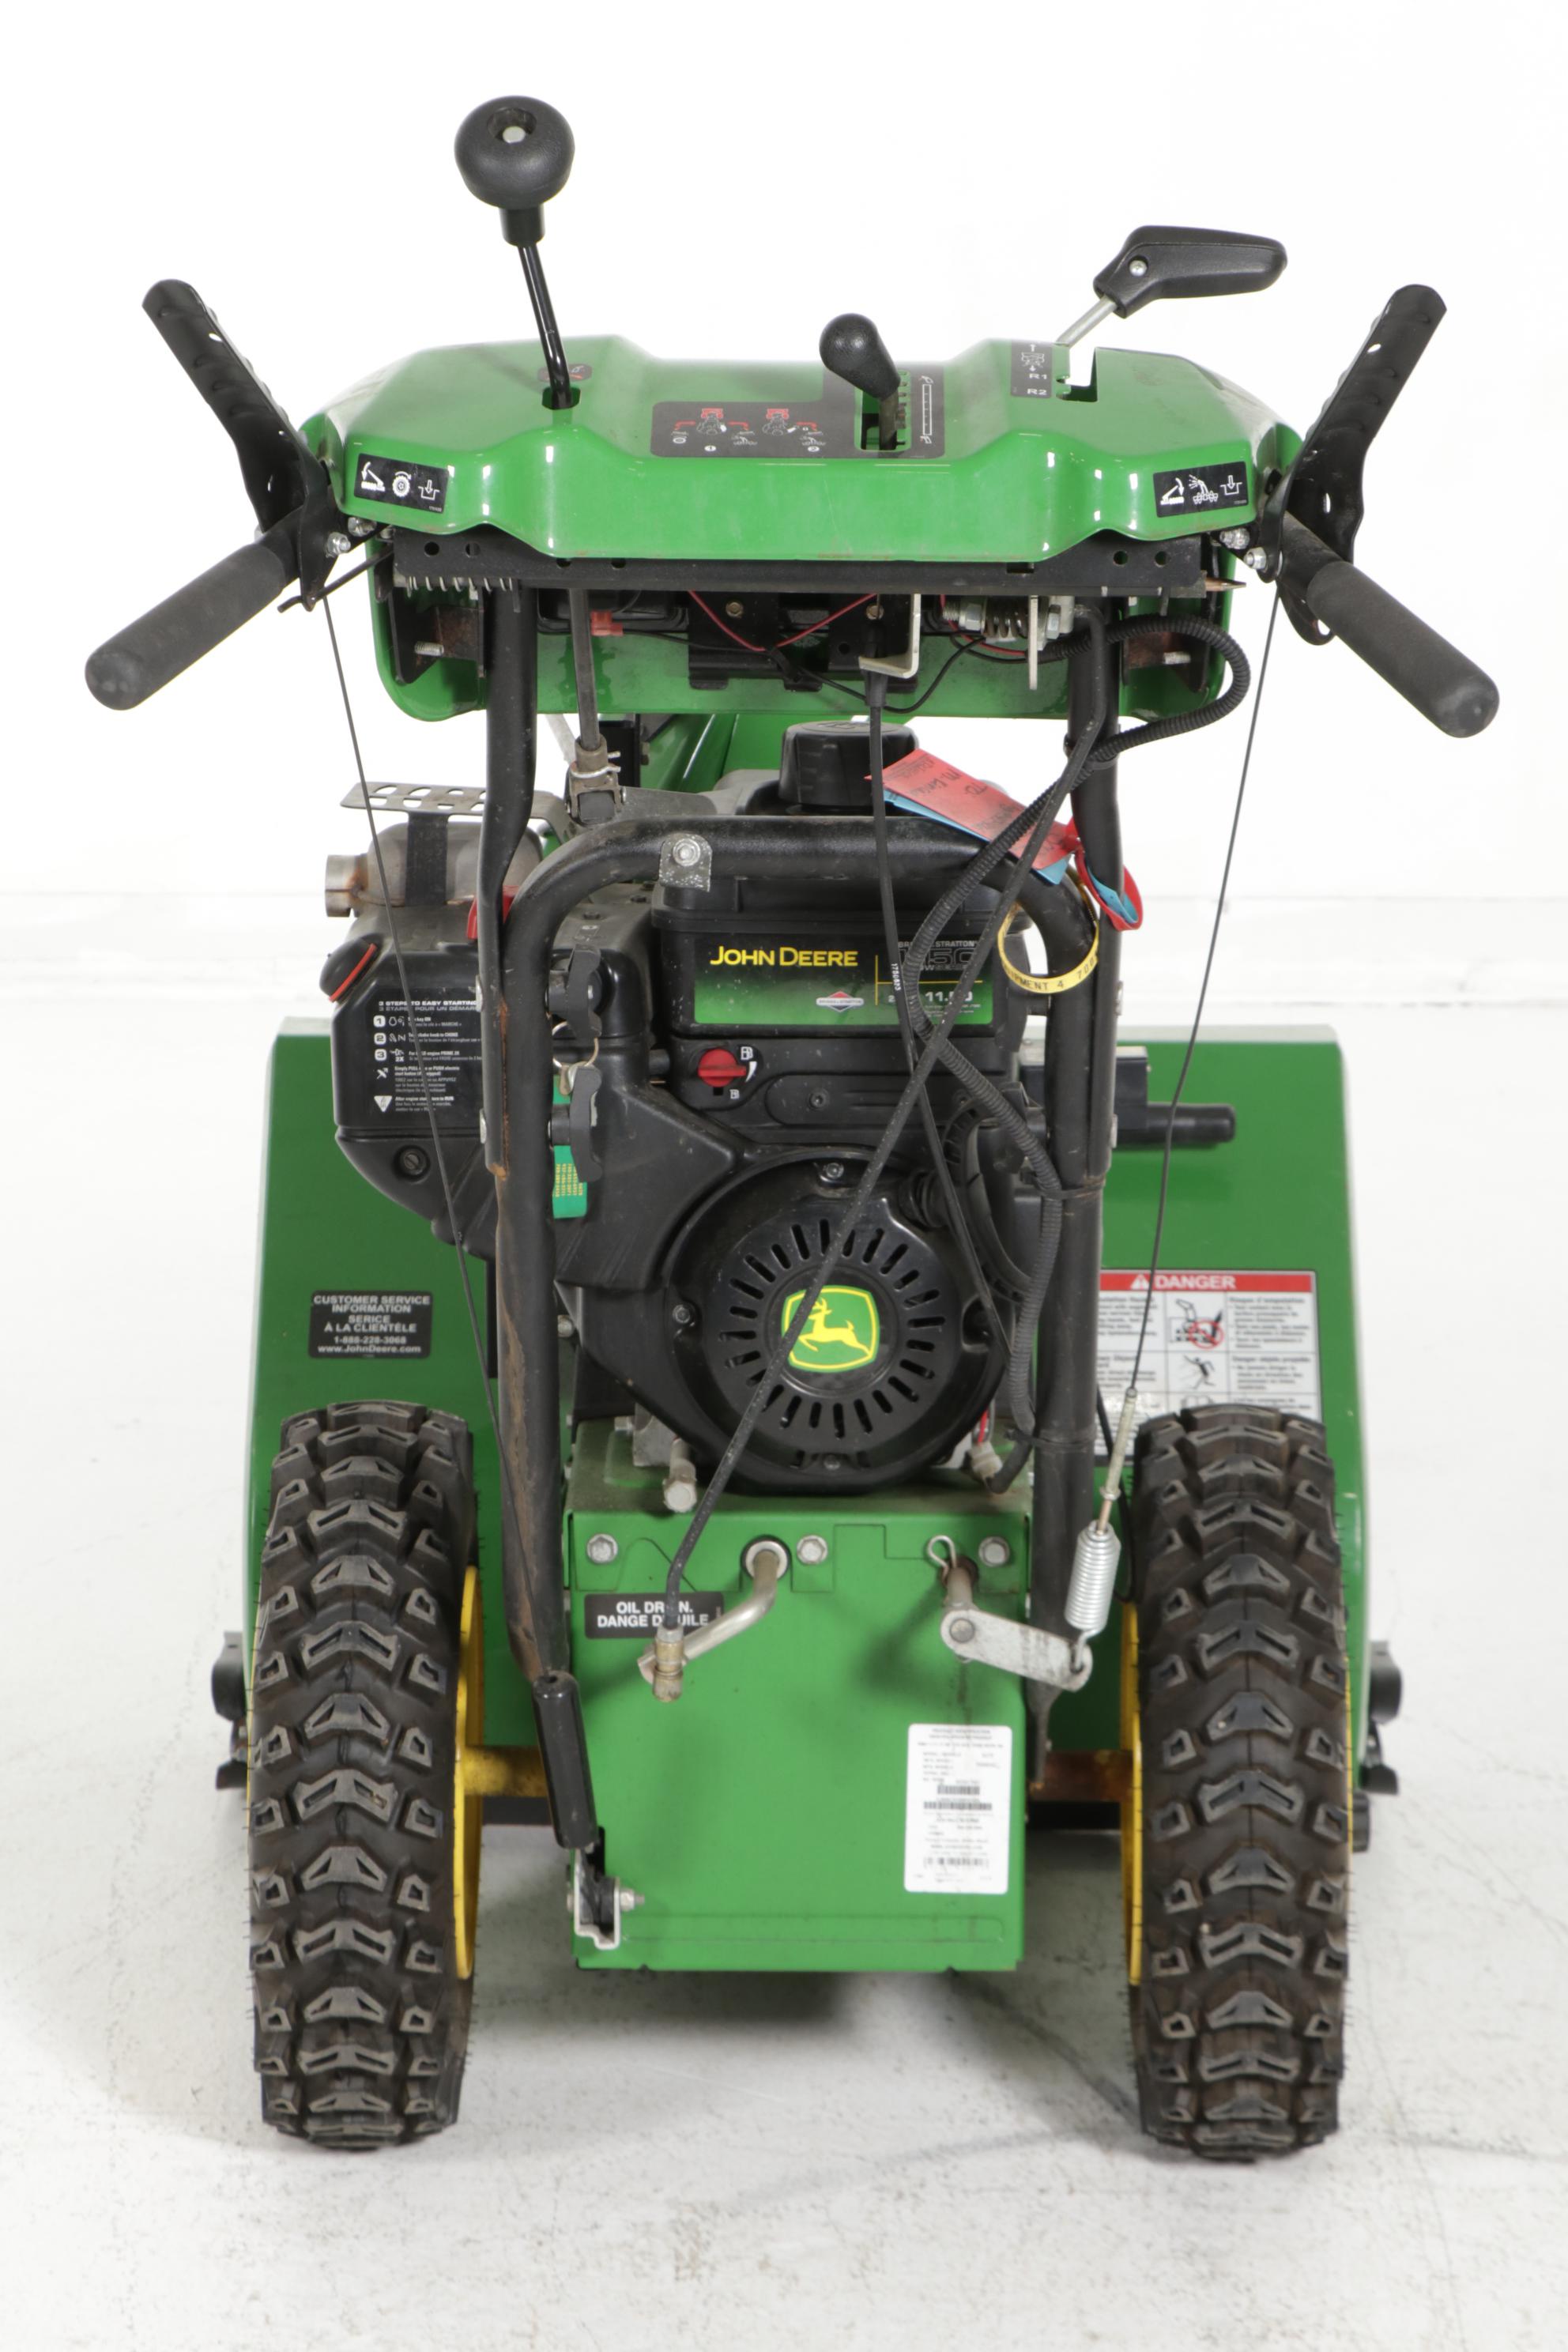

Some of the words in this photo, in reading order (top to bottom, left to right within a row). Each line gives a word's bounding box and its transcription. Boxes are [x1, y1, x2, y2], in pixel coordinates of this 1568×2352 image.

[1155, 1275, 1236, 1289] DANGER
[314, 1295, 378, 1304] CUSTOMER
[381, 1295, 431, 1304] SERVICE
[332, 1304, 412, 1314] INFORMATION
[349, 1314, 391, 1323] SERICE
[616, 1601, 641, 1613] OIL
[597, 1615, 648, 1627] DANGE
